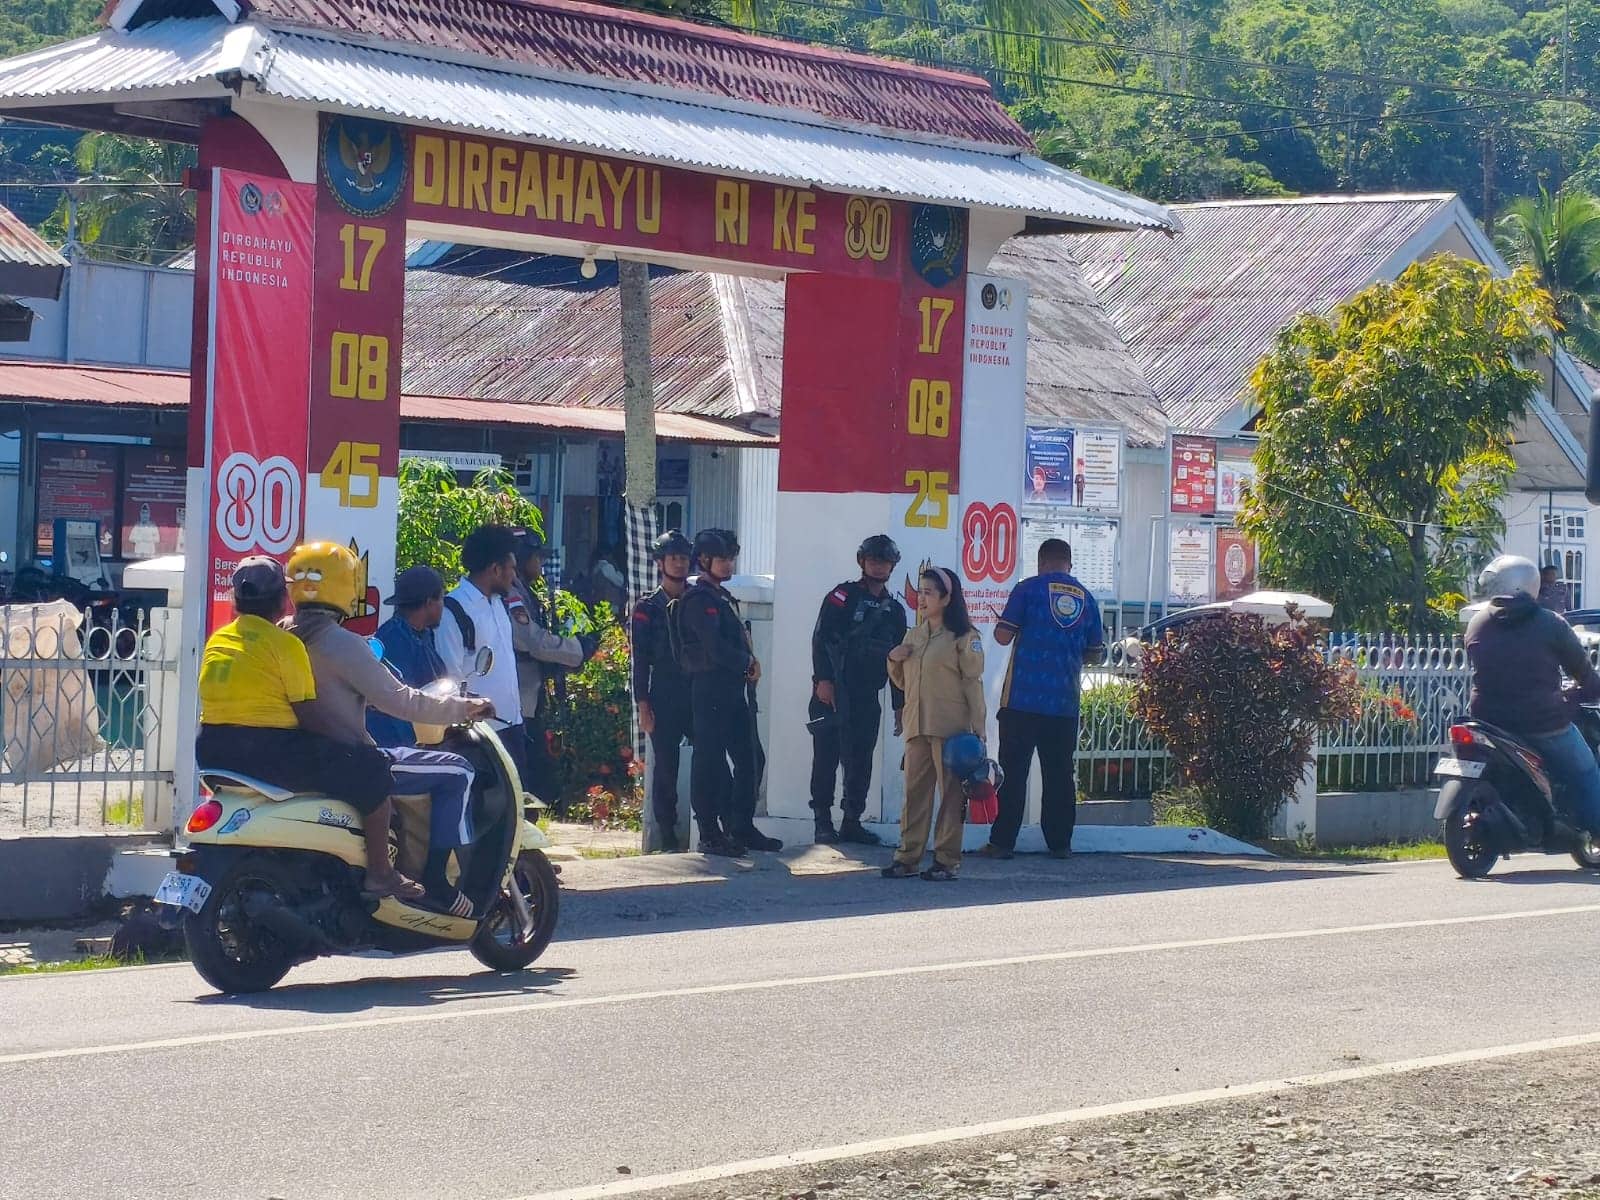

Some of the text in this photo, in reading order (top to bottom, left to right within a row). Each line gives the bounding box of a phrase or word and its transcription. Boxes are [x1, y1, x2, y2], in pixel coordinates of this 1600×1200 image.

[413, 134, 893, 262] DIRGAHAYU RI KE 80
[222, 231, 292, 253] DIRGAHAYU
[222, 249, 282, 270] REPUBLIK
[339, 223, 387, 292] 17
[222, 267, 288, 288] INDONESIA
[918, 296, 955, 354] 17
[971, 323, 1013, 337] DIRGAHAYU
[329, 331, 389, 401] 08
[969, 352, 1010, 366] INDONESIA
[907, 378, 951, 438] 08
[215, 451, 301, 555] 80
[320, 441, 381, 509] 45
[904, 470, 949, 530] 25
[961, 501, 1018, 584] 80
